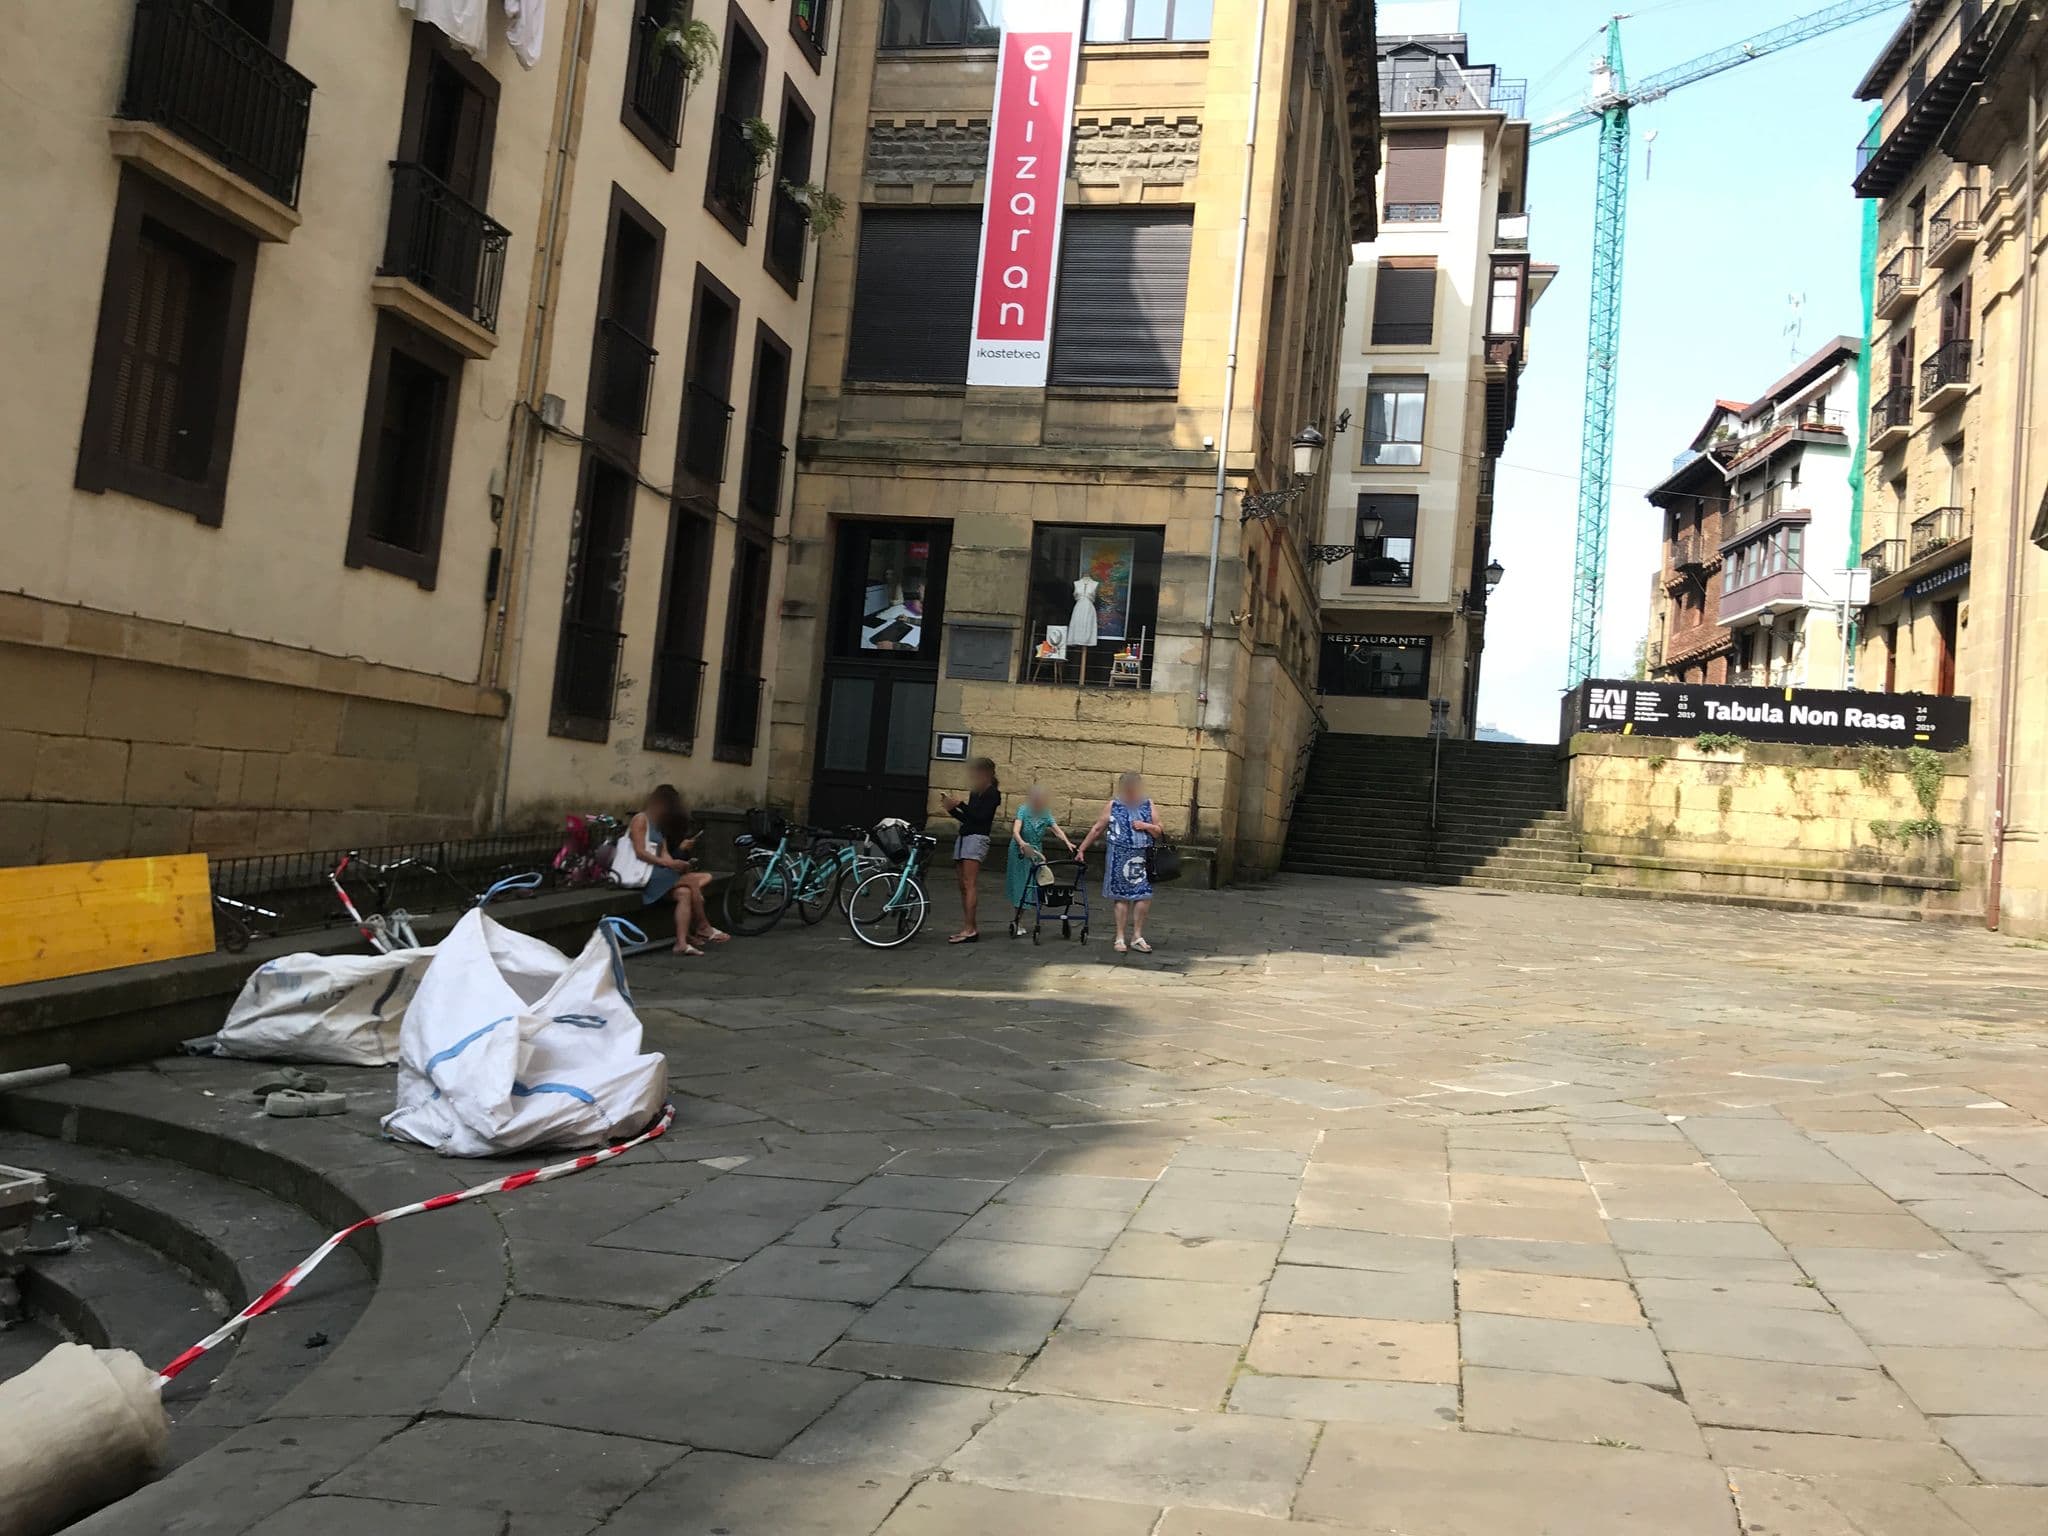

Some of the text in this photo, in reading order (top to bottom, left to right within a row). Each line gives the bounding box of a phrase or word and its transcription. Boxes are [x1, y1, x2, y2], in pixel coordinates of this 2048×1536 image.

[1327, 634, 1426, 646] RESTAURANTE
[1679, 694, 1689, 702] 15
[1676, 711, 1696, 719] 2019
[1704, 701, 1906, 730] Tabula Non Rasa
